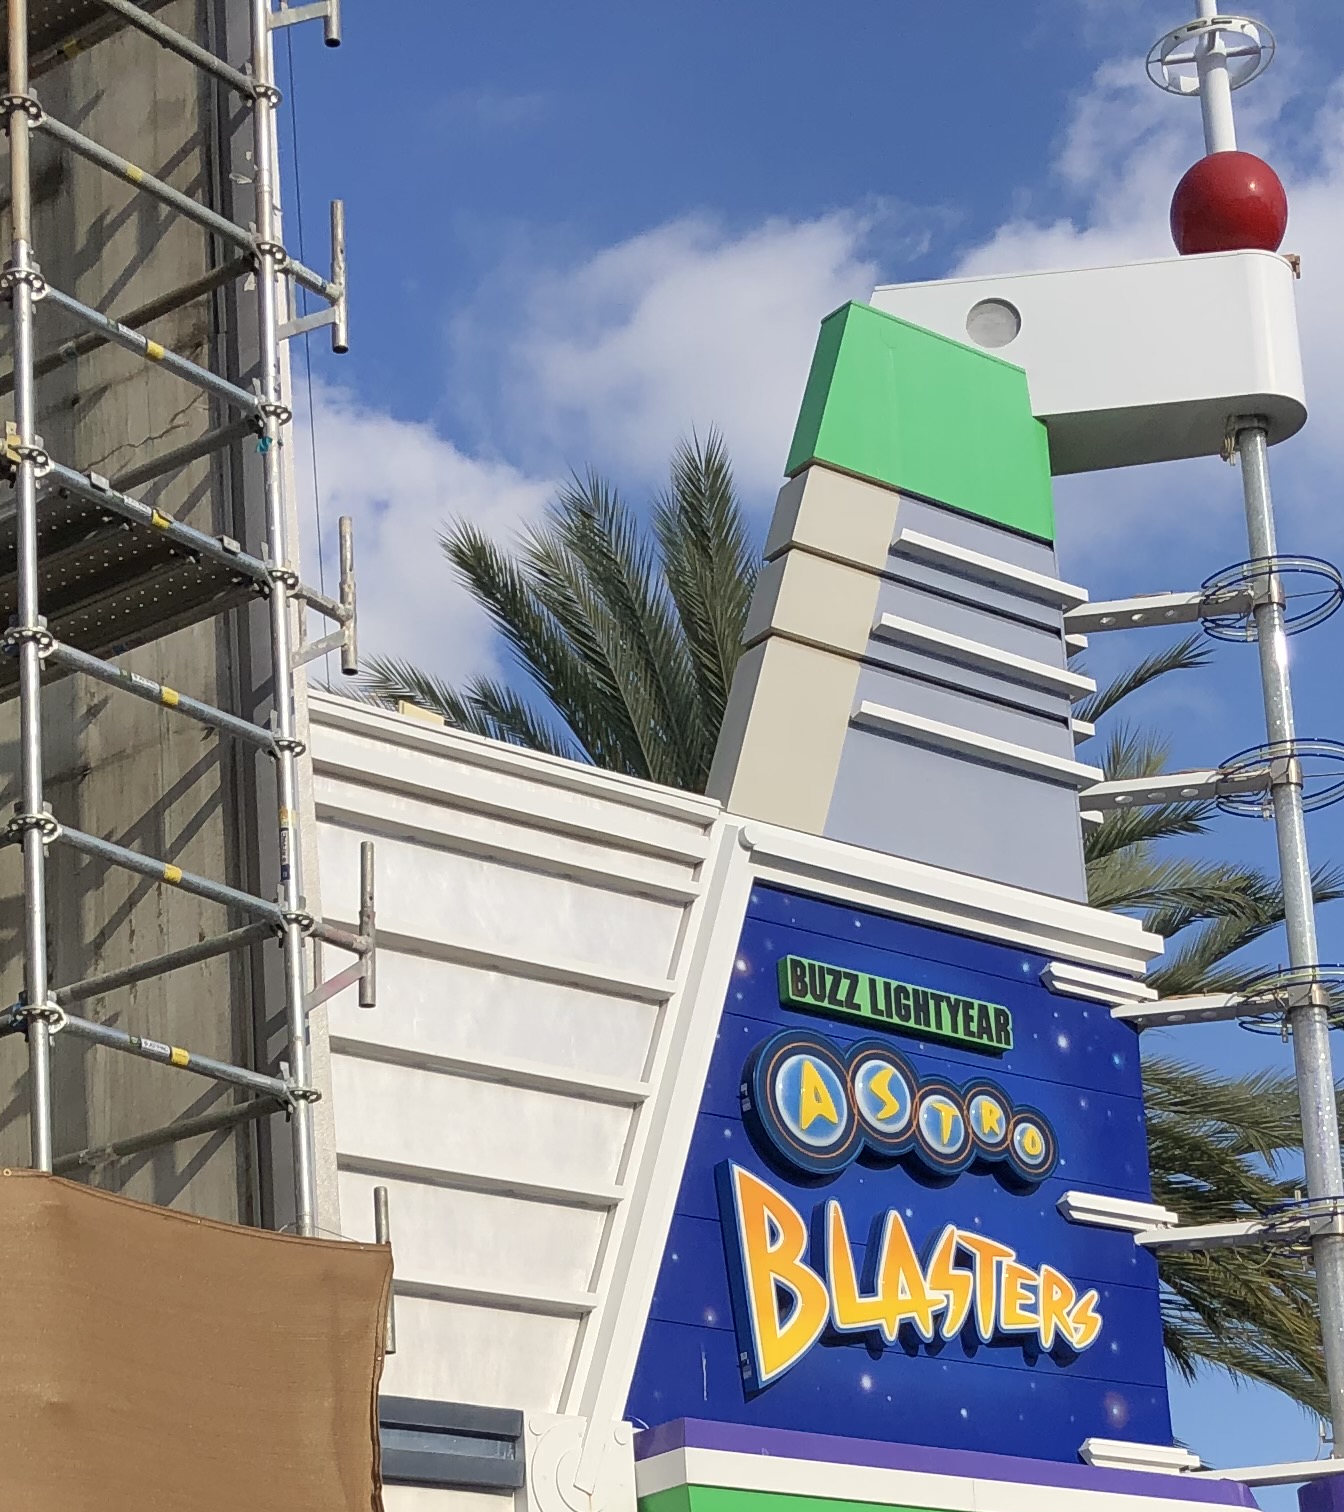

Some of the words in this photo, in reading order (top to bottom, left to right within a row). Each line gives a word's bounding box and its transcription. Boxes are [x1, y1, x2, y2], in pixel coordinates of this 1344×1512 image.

[787, 956, 862, 1013] BUZZ
[868, 980, 1013, 1048] LIGHTYEAR
[731, 1164, 1103, 1384] BLASTERS
